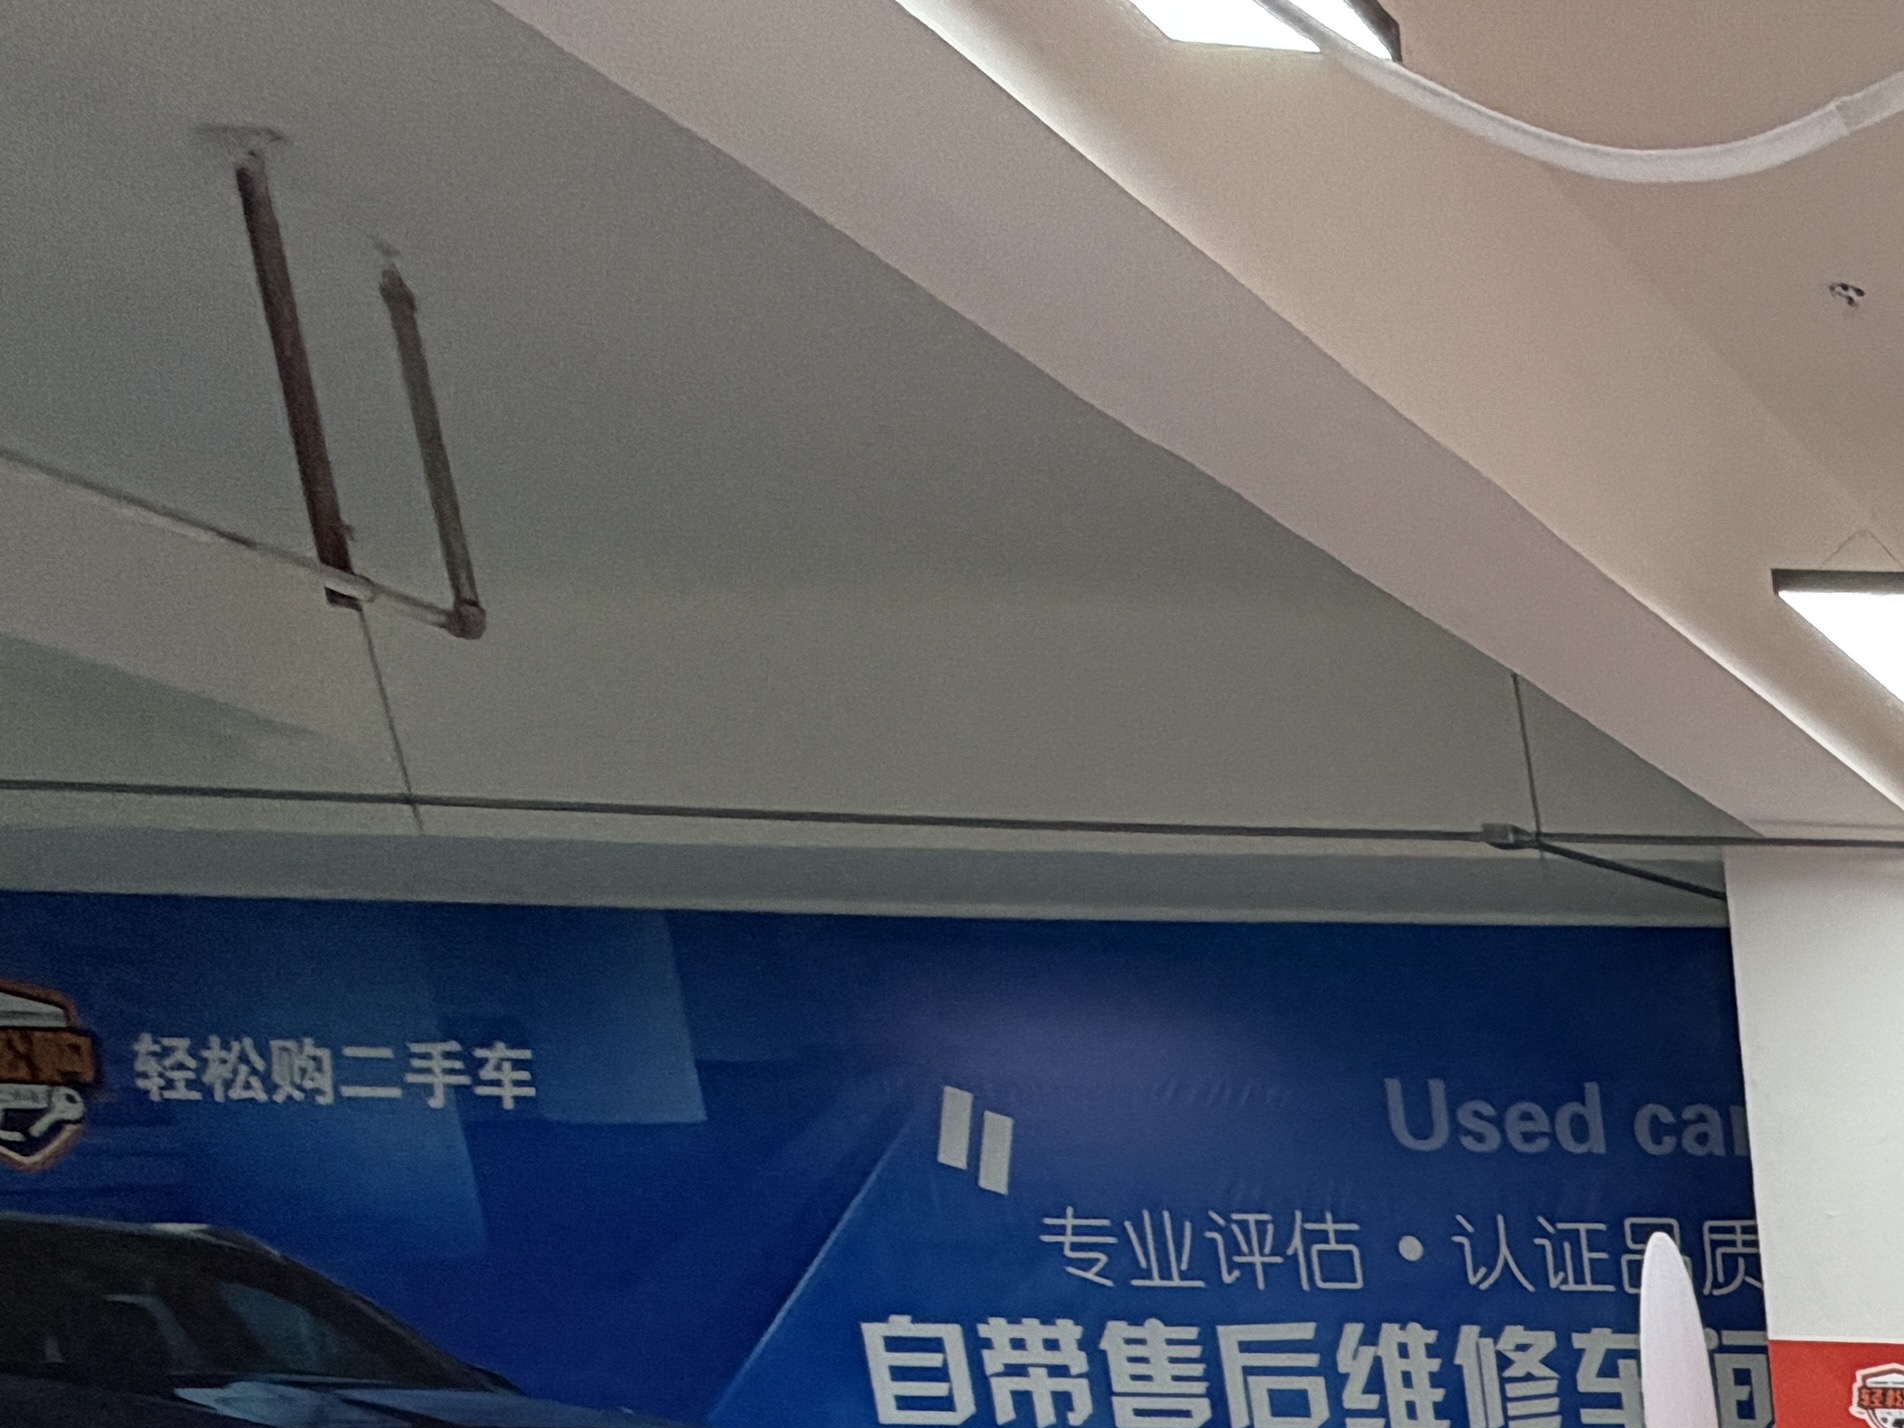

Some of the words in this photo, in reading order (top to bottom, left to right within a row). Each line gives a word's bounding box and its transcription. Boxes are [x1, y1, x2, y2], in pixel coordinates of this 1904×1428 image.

[130, 1033, 537, 1110] 轻松购二手车
[1384, 1077, 1607, 1155] Used
[1039, 1206, 1365, 1291] 专业评估
